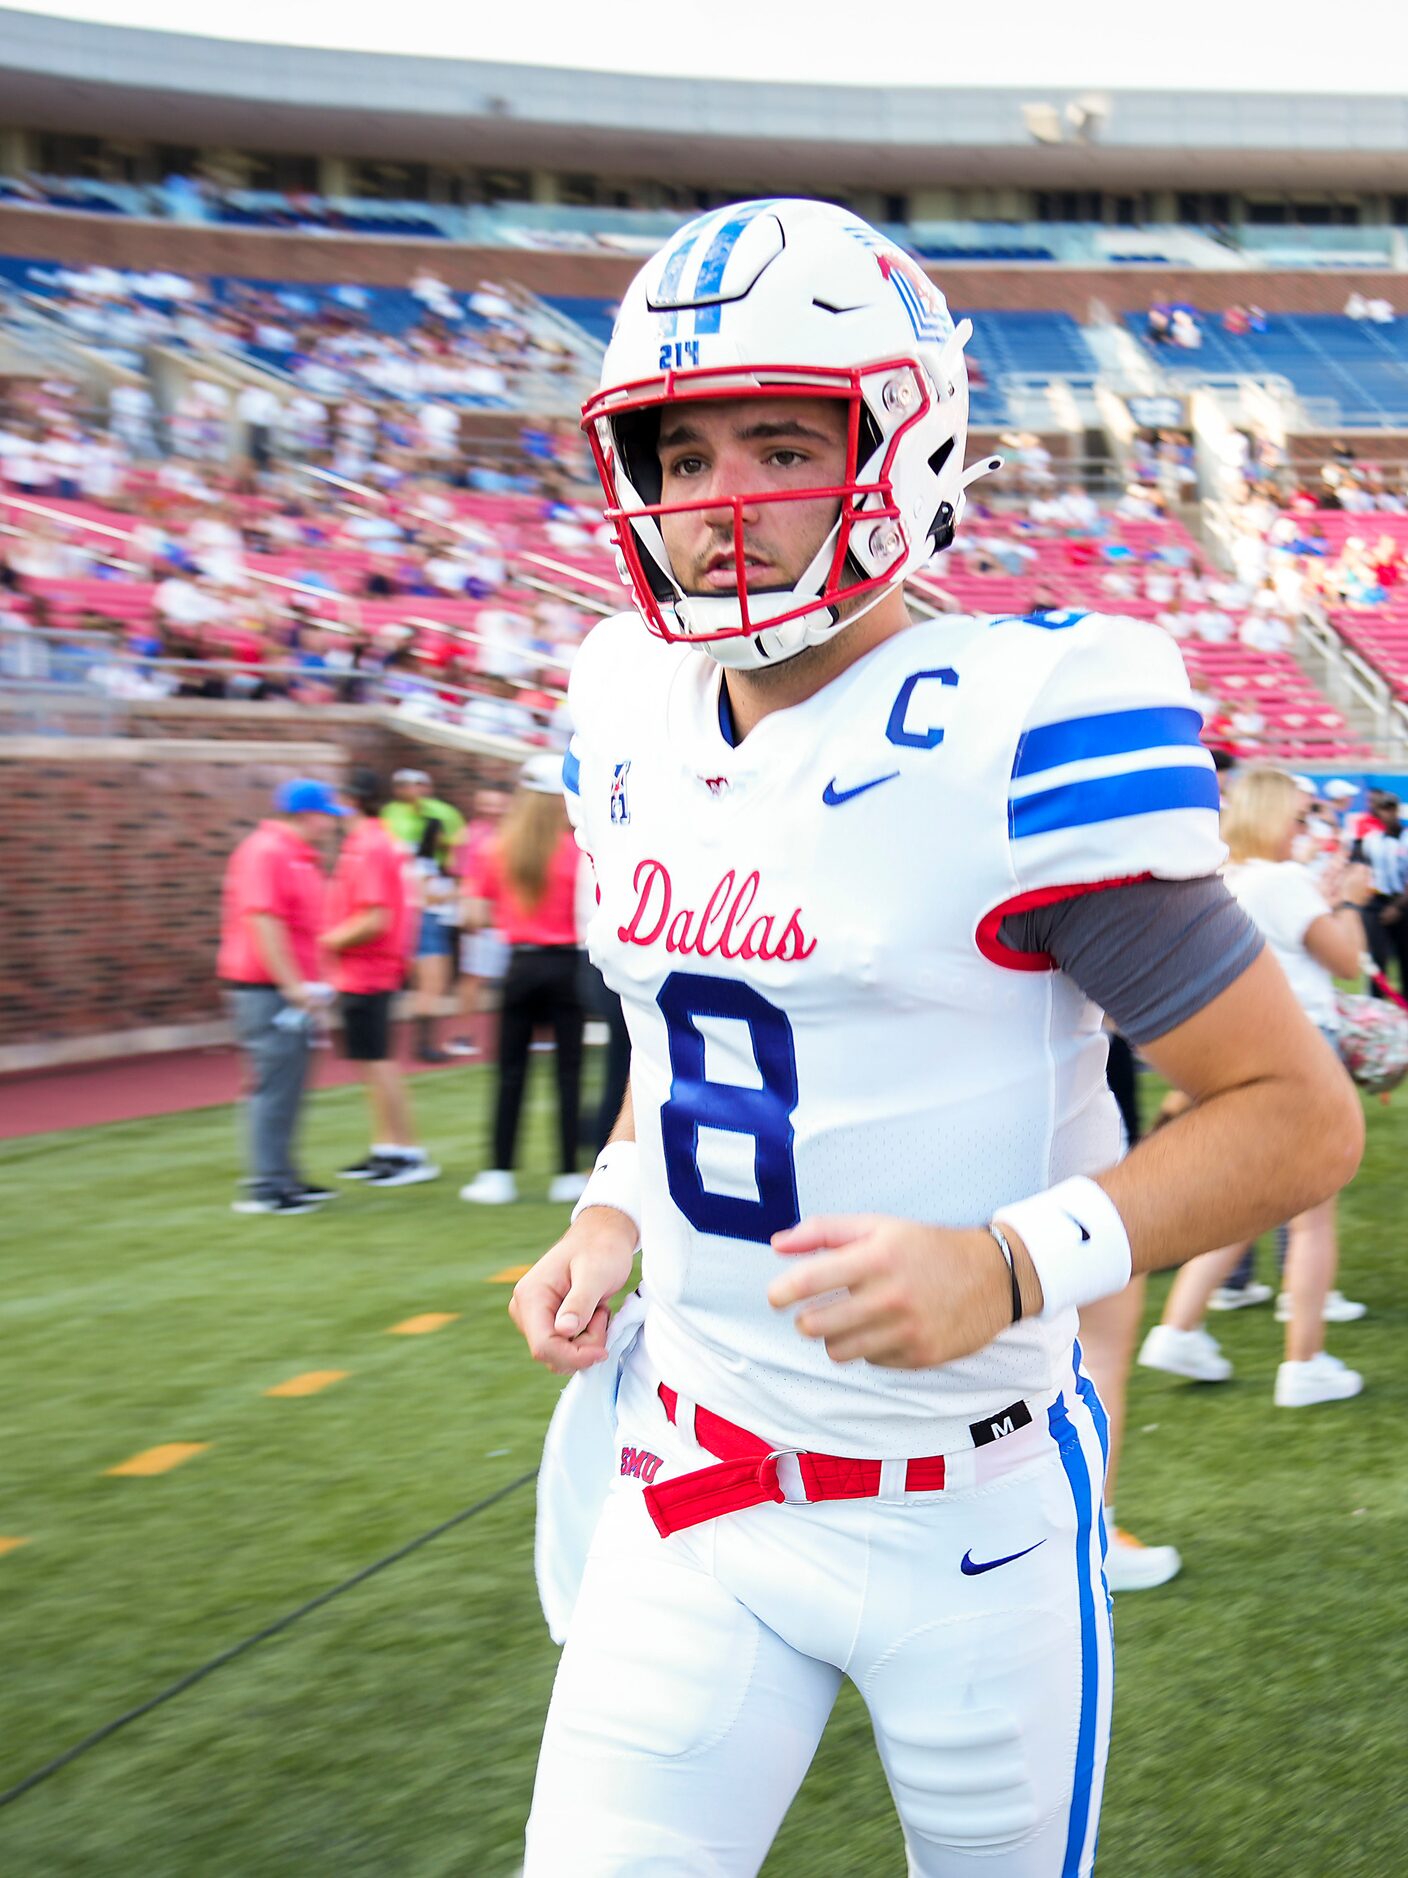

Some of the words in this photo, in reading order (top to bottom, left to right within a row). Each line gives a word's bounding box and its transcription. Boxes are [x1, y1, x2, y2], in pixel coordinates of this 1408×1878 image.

[659, 340, 699, 370] 214
[886, 668, 959, 750] C
[617, 859, 817, 961] Dallas
[656, 971, 800, 1246] 8
[991, 1416, 1015, 1440] M
[620, 1446, 664, 1484] SMU
